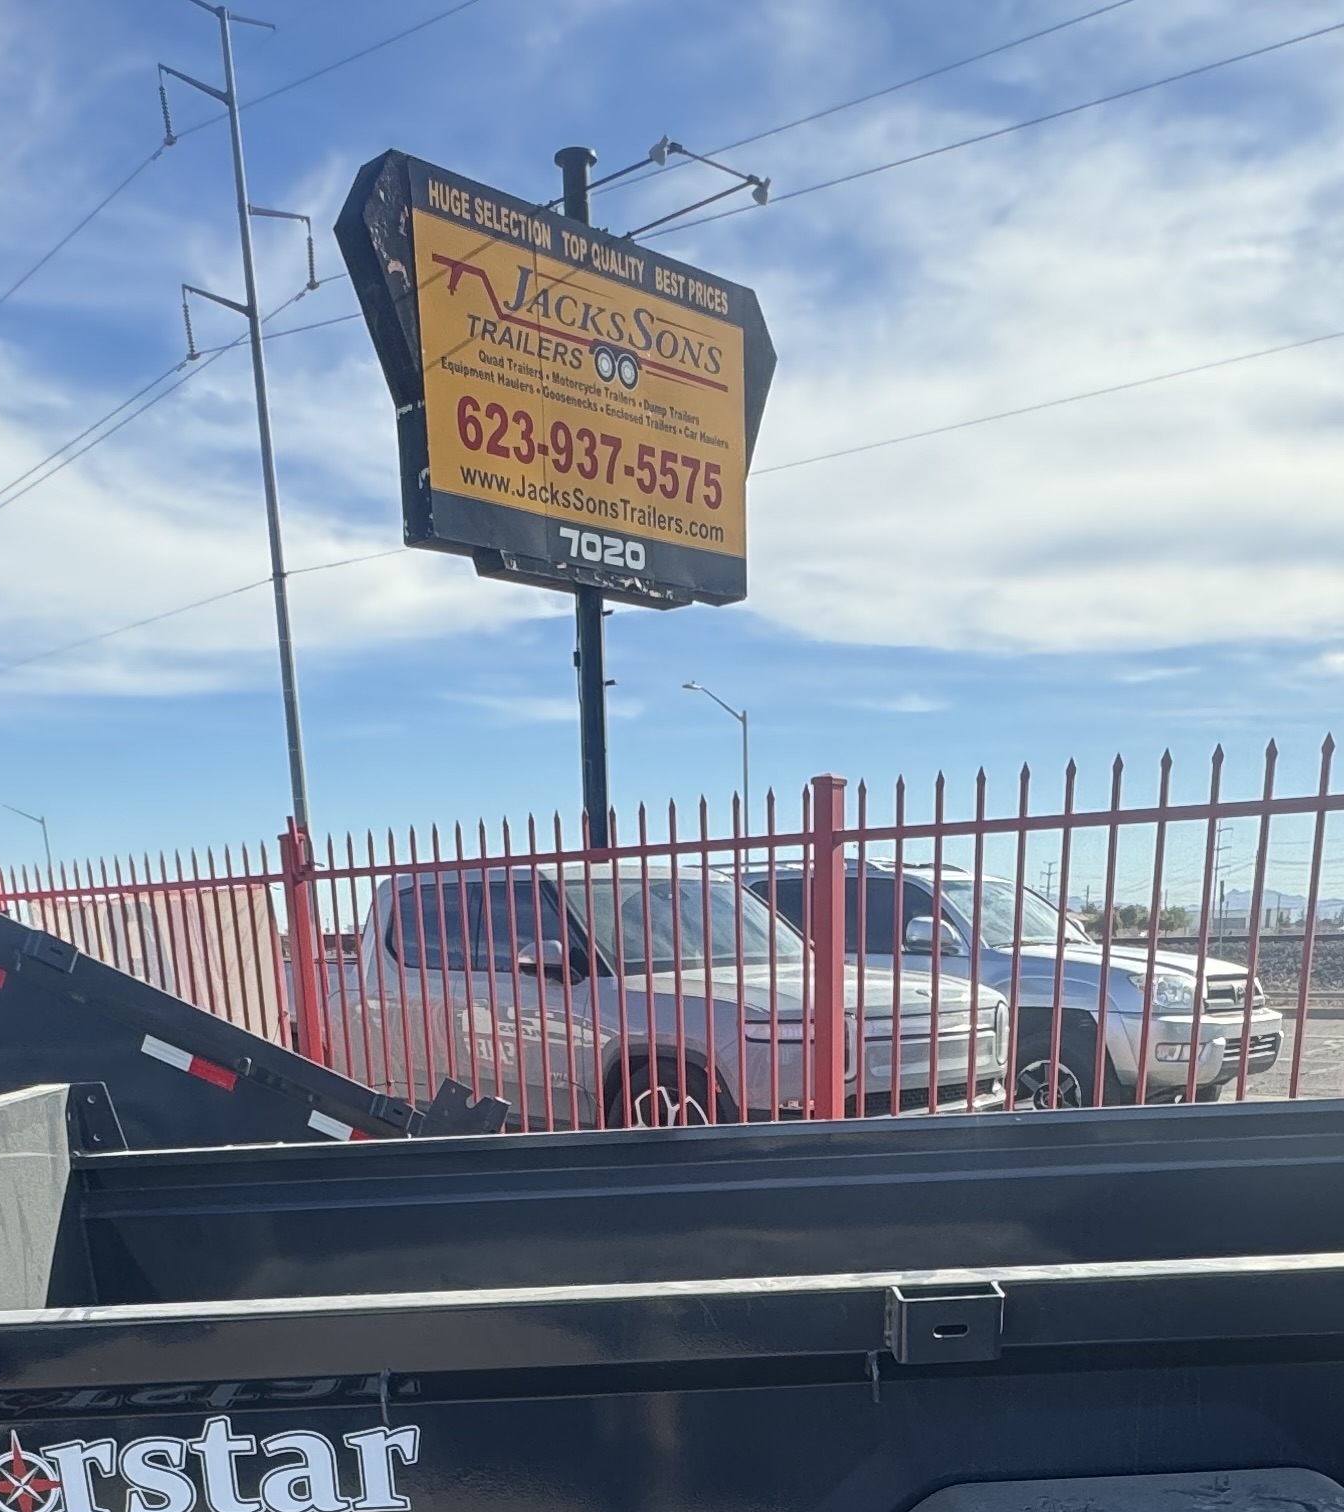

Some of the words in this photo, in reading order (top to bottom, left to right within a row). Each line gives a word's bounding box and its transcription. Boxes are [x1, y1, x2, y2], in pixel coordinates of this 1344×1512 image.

[428, 179, 471, 220] HUGE
[474, 197, 552, 250] SELECTION
[561, 231, 588, 262] TOP
[591, 243, 646, 283] QUALITY
[655, 266, 685, 299] BEST
[688, 278, 729, 315] PRICES
[466, 314, 583, 371] TRAILERS
[478, 349, 505, 369] Quad
[507, 360, 544, 381] Trailers
[604, 386, 637, 407] Trailers
[440, 356, 495, 384] Equipment
[497, 372, 535, 395] Haulers
[605, 404, 644, 426] Enclosed
[645, 415, 677, 436] Trailers
[683, 425, 698, 441] Car
[456, 395, 724, 511] 623-937-5575
[460, 464, 725, 544] www.JacksSonsTrailers.com
[558, 526, 647, 570] 7020
